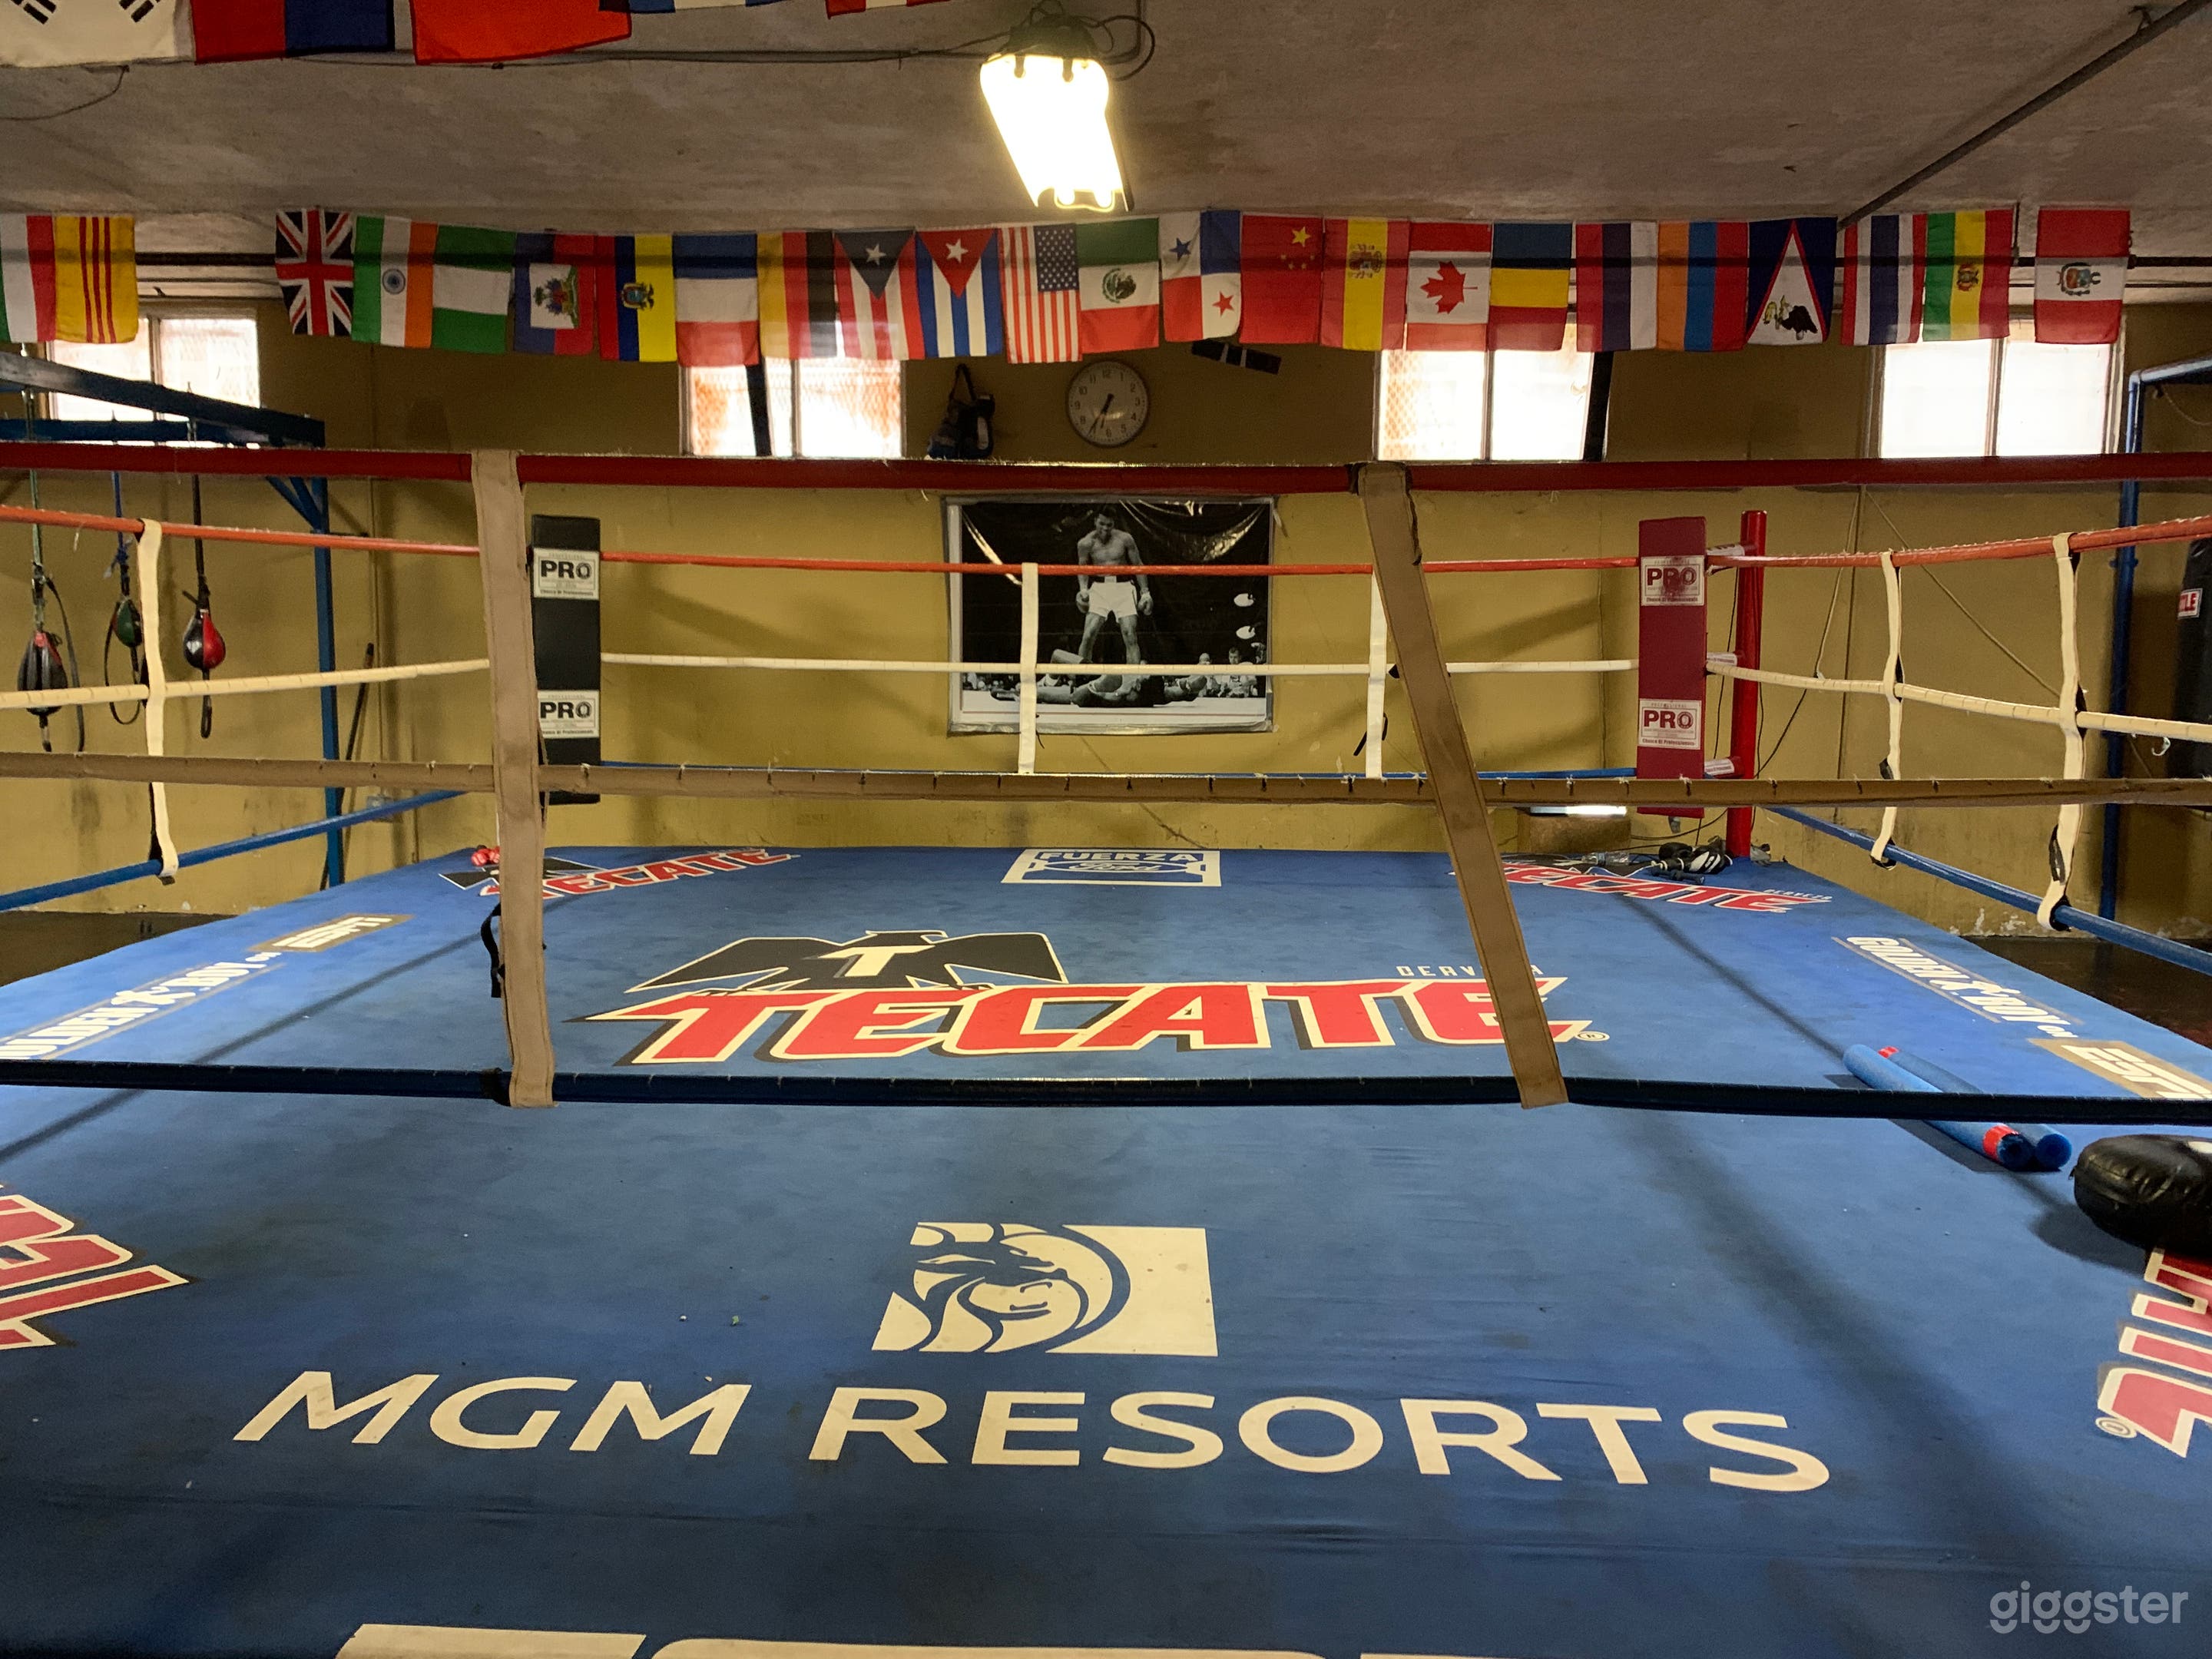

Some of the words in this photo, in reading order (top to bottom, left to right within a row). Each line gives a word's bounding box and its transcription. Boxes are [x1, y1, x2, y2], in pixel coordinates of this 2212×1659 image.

[541, 560, 592, 579] PRO
[1647, 568, 1697, 586] PRO
[540, 702, 592, 719] PRO
[1644, 710, 1694, 729] PRO
[480, 848, 793, 899] ECATE
[1040, 852, 1198, 862] FUERZA
[1068, 861, 1162, 872] Ford
[1449, 862, 1833, 912] ECATE
[272, 916, 392, 949] ESPN
[1846, 936, 1971, 979] GOLDEN
[1960, 995, 2071, 1026] BOY
[0, 1007, 159, 1059] OLDEN
[159, 962, 267, 987] BOY
[585, 976, 1593, 1066] TECATE
[233, 1370, 752, 1456] MGM
[808, 1386, 1830, 1493] RESORTS
